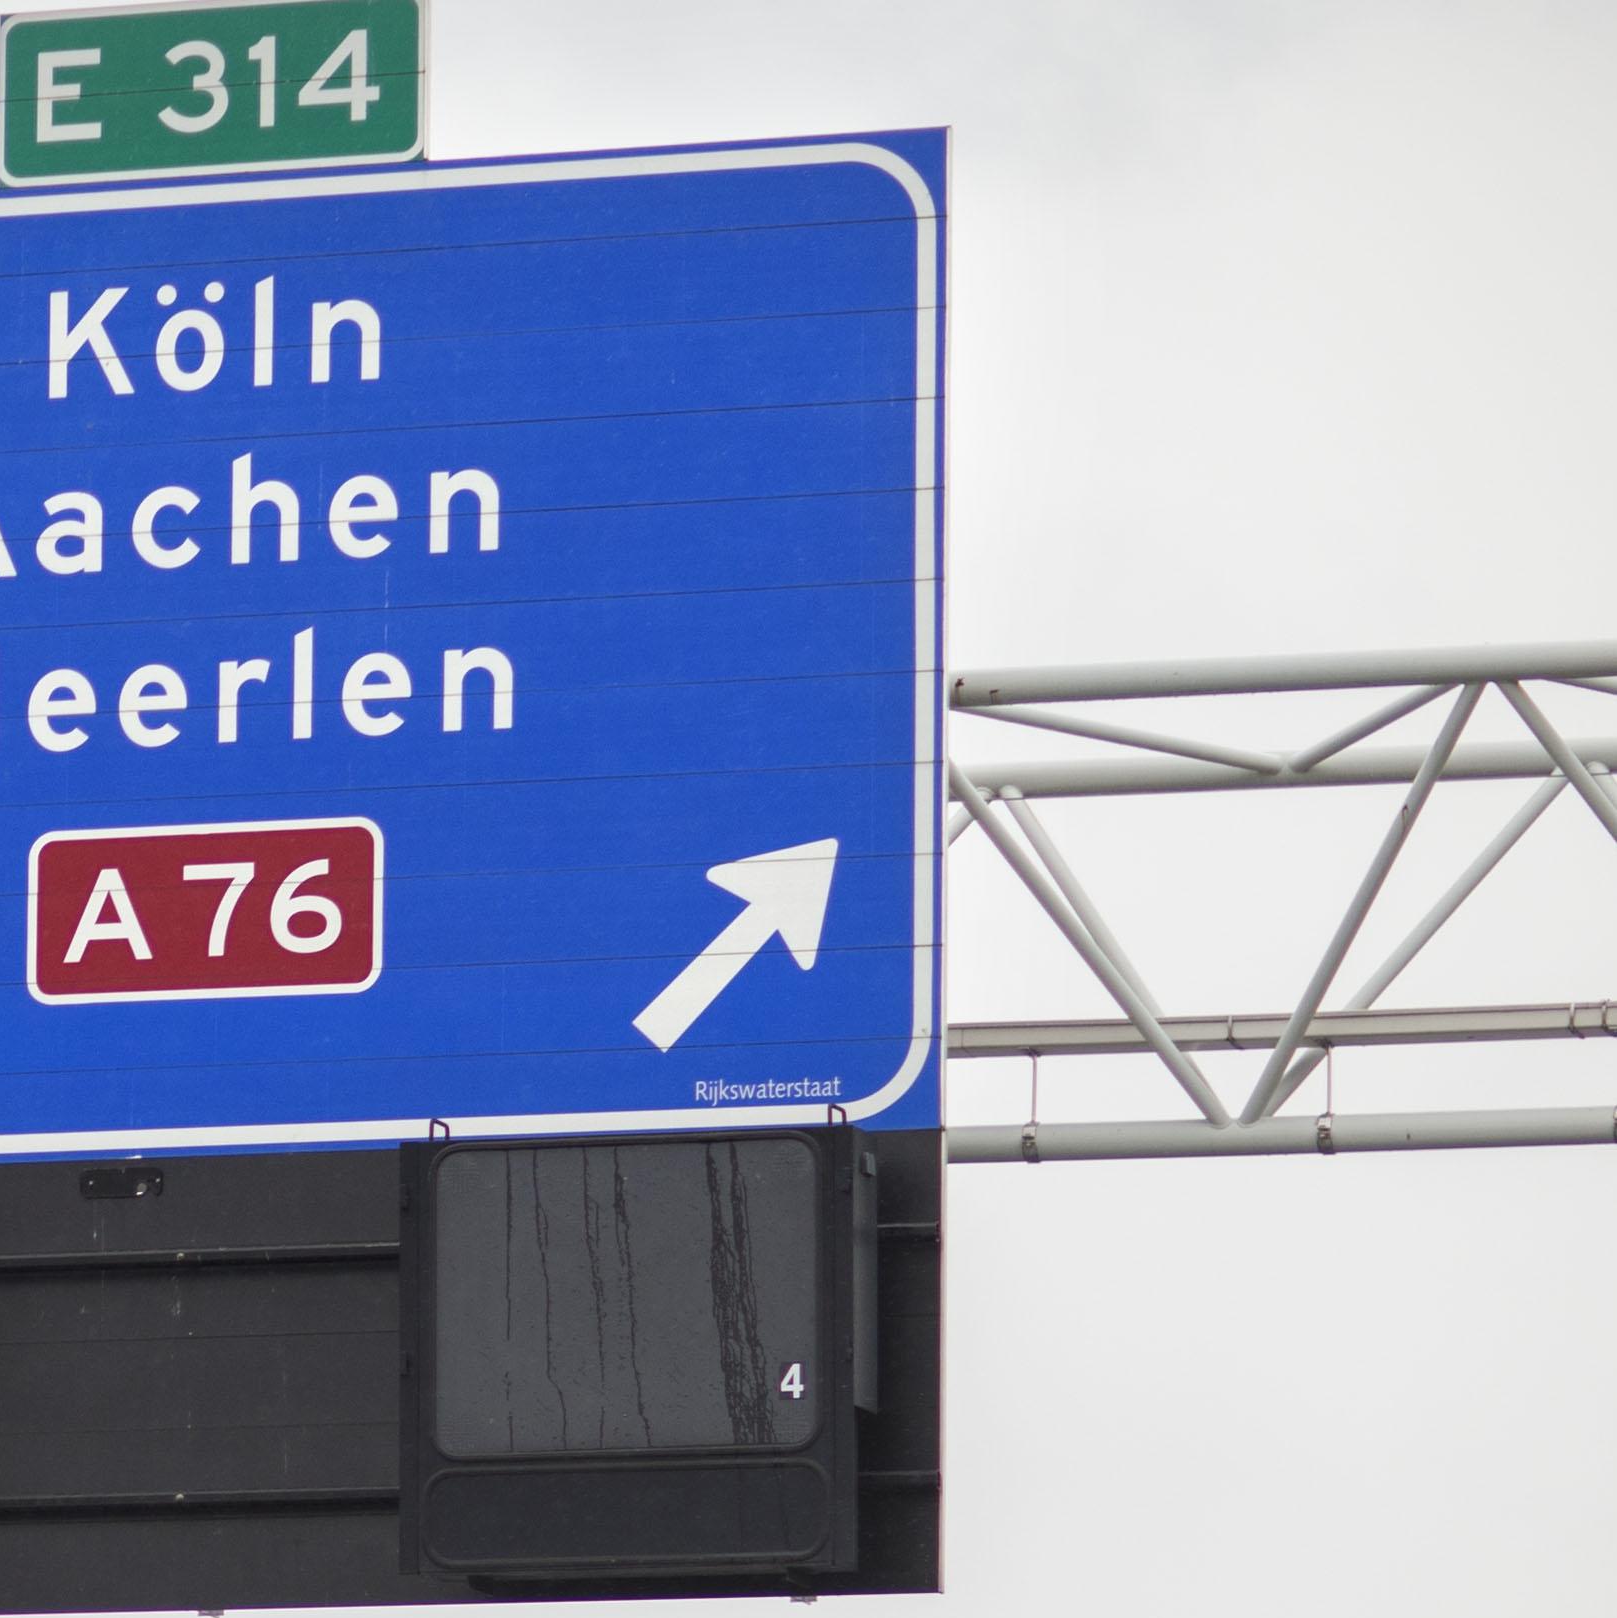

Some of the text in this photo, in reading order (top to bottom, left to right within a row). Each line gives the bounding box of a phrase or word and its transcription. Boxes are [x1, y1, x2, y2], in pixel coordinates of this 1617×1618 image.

[36, 29, 380, 143] E 314
[48, 275, 381, 399] Köln
[694, 1076, 842, 1107] Rijkswaterstaat
[780, 1363, 804, 1399] 4
